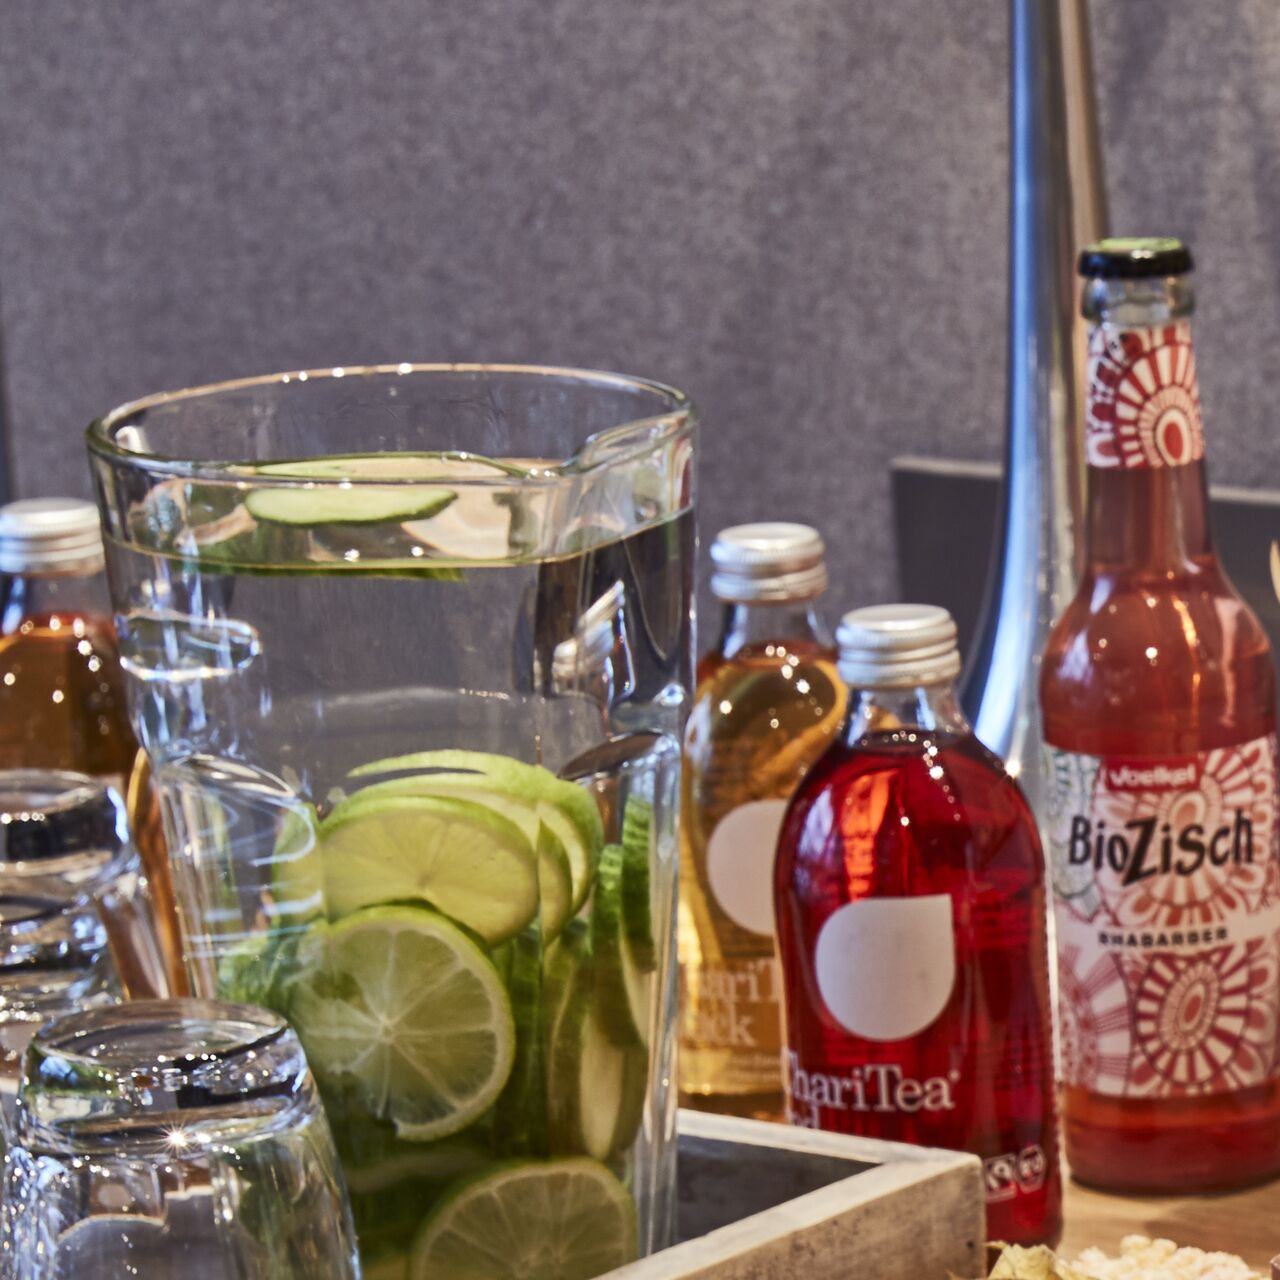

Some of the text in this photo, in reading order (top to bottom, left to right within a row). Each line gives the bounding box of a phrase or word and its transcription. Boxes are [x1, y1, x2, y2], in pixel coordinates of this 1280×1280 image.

[1069, 808, 1254, 886] BioZisch
[1099, 926, 1228, 947] RHABARBER
[785, 1048, 955, 1112] hariTea
